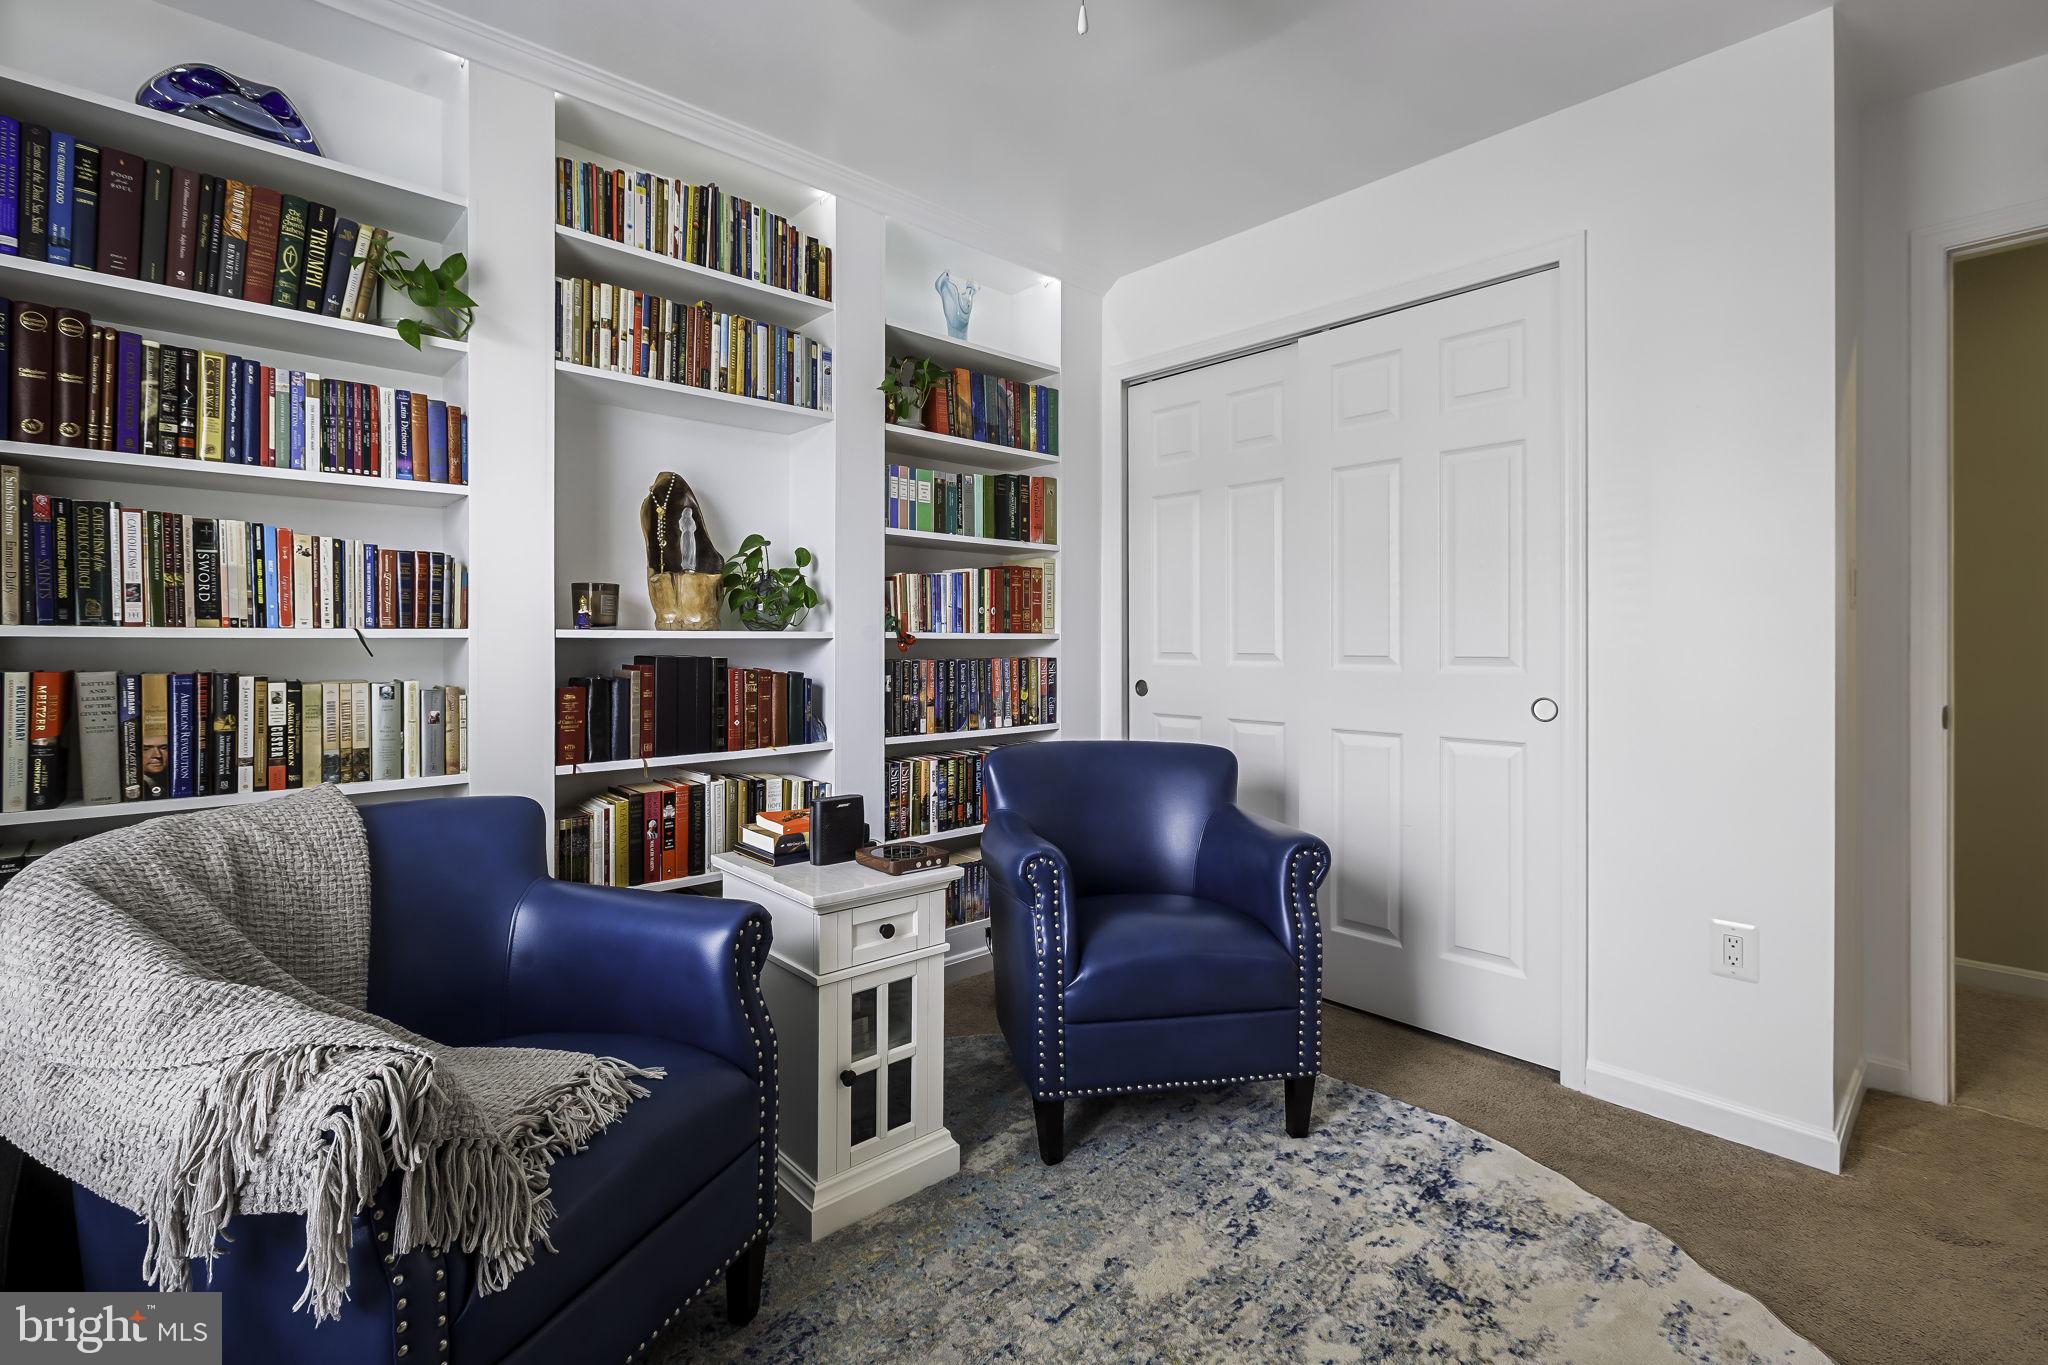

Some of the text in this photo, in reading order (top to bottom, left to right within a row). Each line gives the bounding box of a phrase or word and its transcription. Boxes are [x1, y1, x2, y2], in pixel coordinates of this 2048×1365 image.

[31, 142, 45, 234] Jesus and the Dead Sea Scrolls
[56, 141, 65, 204] THE GENESIS FLOOD
[230, 189, 245, 233] TRIED BY FIRE
[211, 214, 220, 254] EUCHARIST
[225, 243, 235, 280] BENNETT
[304, 228, 328, 289] TRIUMPH
[205, 381, 214, 417] LEWIS
[400, 402, 409, 457] Latin Dictionary
[57, 517, 66, 540] CATHOLIC
[91, 507, 106, 572] CATECHISM of the
[127, 519, 137, 569] CATHOLICISM
[6, 540, 17, 568] Eamon
[40, 548, 46, 556] OF
[57, 541, 66, 559] BELIEFS
[77, 506, 91, 589] CATHOLIC CHURCH
[38, 559, 52, 599] SAINTS
[57, 569, 67, 598] TRADITIONS
[197, 554, 210, 602] SWORD
[1048, 663, 1056, 684] Silva
[16, 686, 26, 741] REVOLUTIONARY
[35, 685, 47, 731] MELTZER
[48, 695, 58, 721] BRAD
[128, 690, 136, 714] ABRAMS
[128, 722, 136, 752] LINCOLN'S
[181, 693, 190, 778] AMERICAN REVOLUTION
[271, 727, 283, 757] CUSTER
[341, 722, 351, 742] ANGELS
[33, 758, 41, 794] CONSPIRACY
[129, 766, 137, 785] TRIAL
[890, 769, 900, 795] Silva
[901, 768, 910, 794] Silva
